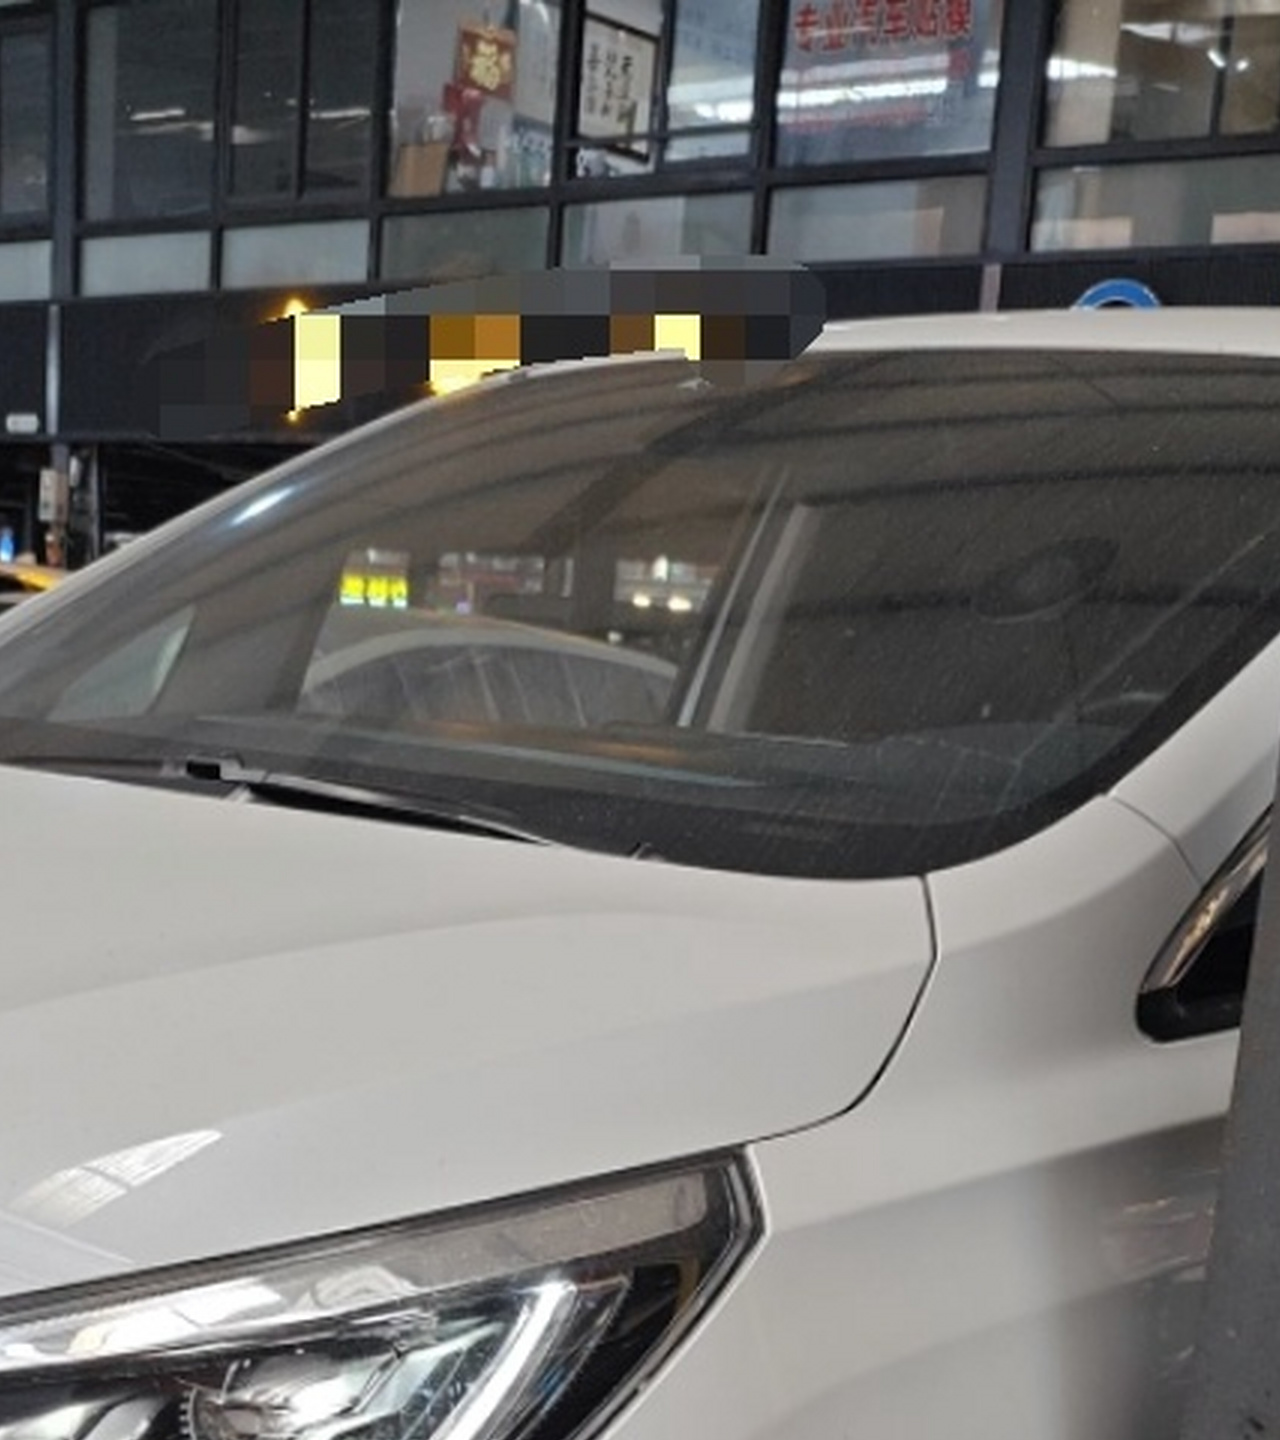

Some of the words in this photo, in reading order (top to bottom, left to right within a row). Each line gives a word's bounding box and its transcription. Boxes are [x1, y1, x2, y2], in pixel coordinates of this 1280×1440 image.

[794, 0, 972, 52] 专业汽车贴膜
